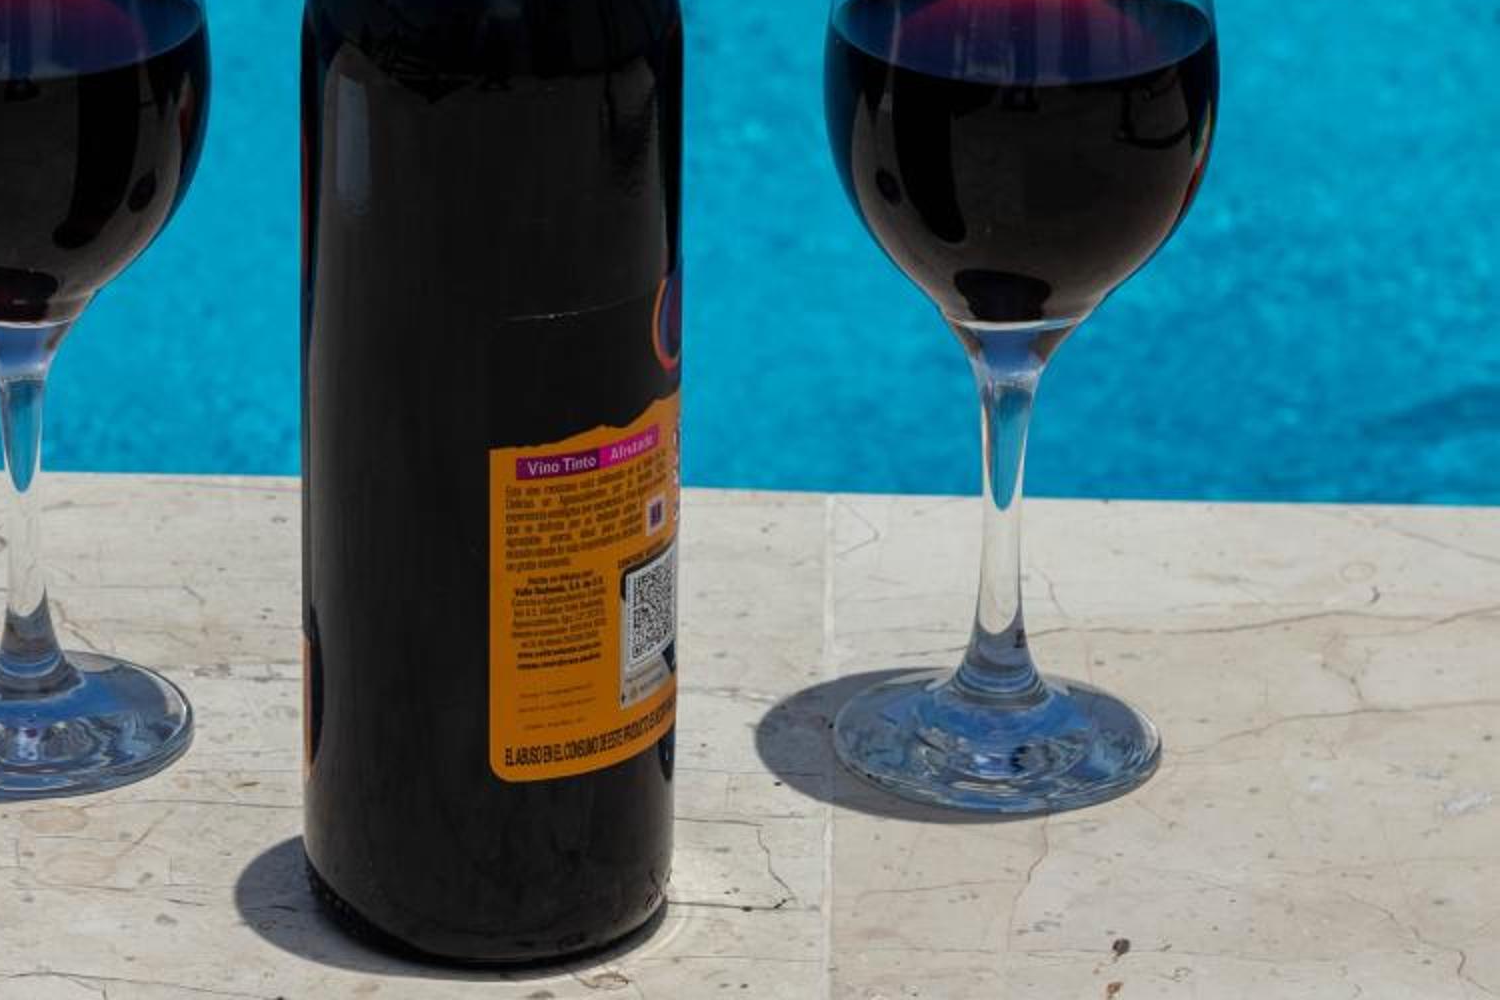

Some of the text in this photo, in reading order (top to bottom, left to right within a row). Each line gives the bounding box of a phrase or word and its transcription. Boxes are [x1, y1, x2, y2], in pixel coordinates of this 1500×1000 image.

[527, 460, 560, 476] Vino
[562, 455, 597, 471] Tinto
[505, 747, 514, 766] EL
[516, 744, 542, 765] ABUSO
